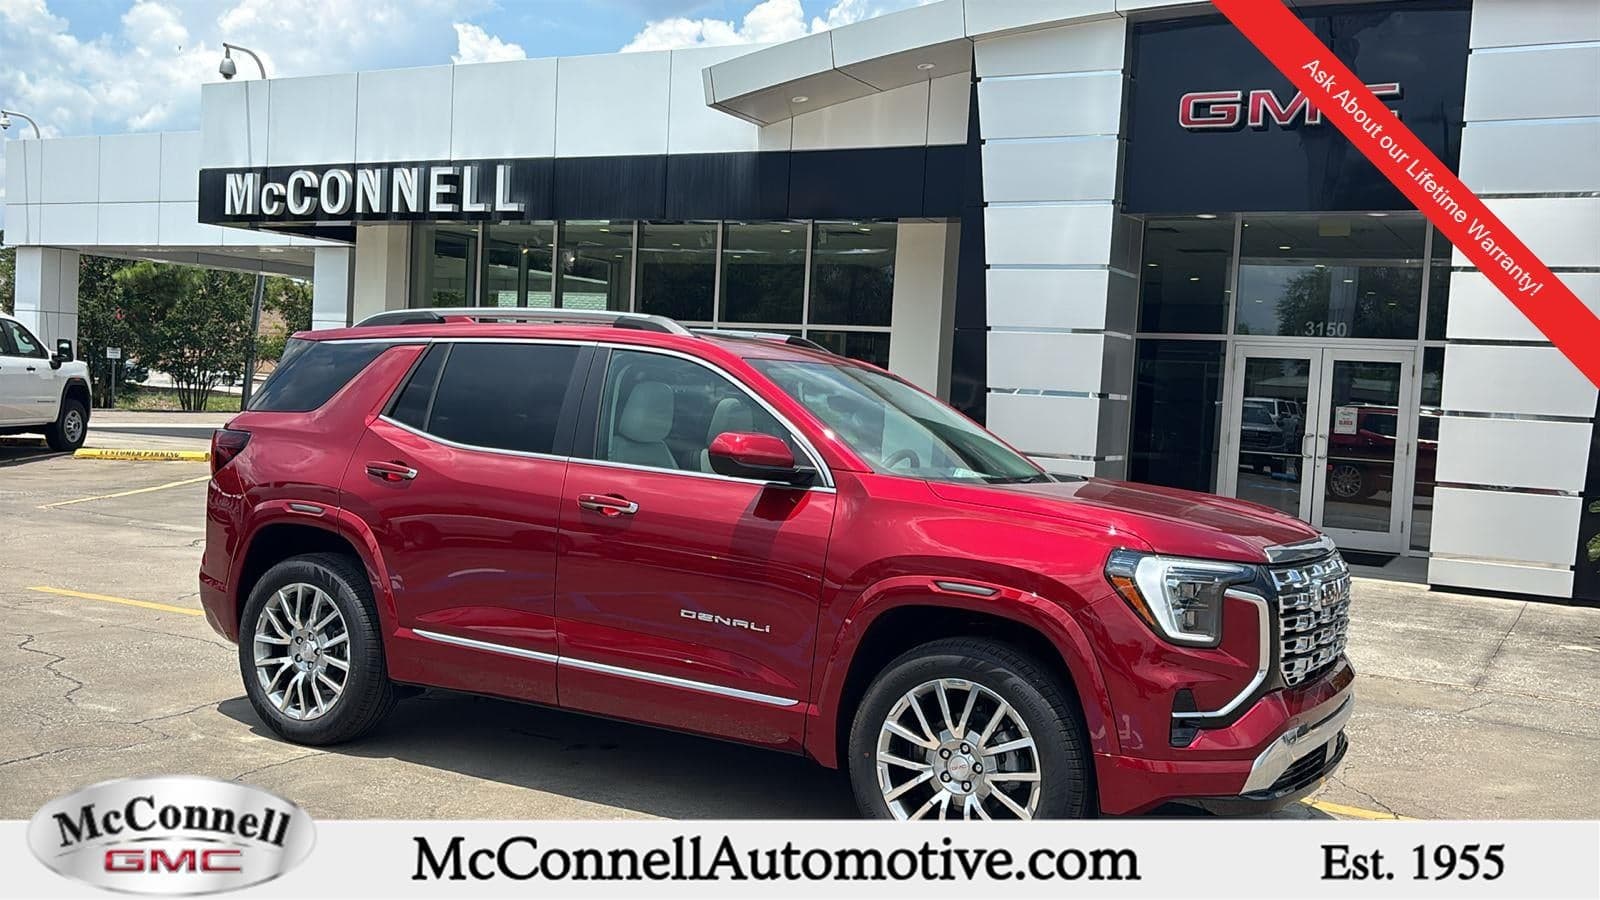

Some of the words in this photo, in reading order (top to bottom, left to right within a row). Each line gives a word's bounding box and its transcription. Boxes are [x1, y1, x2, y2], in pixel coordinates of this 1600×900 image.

[224, 163, 525, 216] McCONNELL
[1305, 320, 1347, 336] 3150
[680, 608, 771, 633] DENALI
